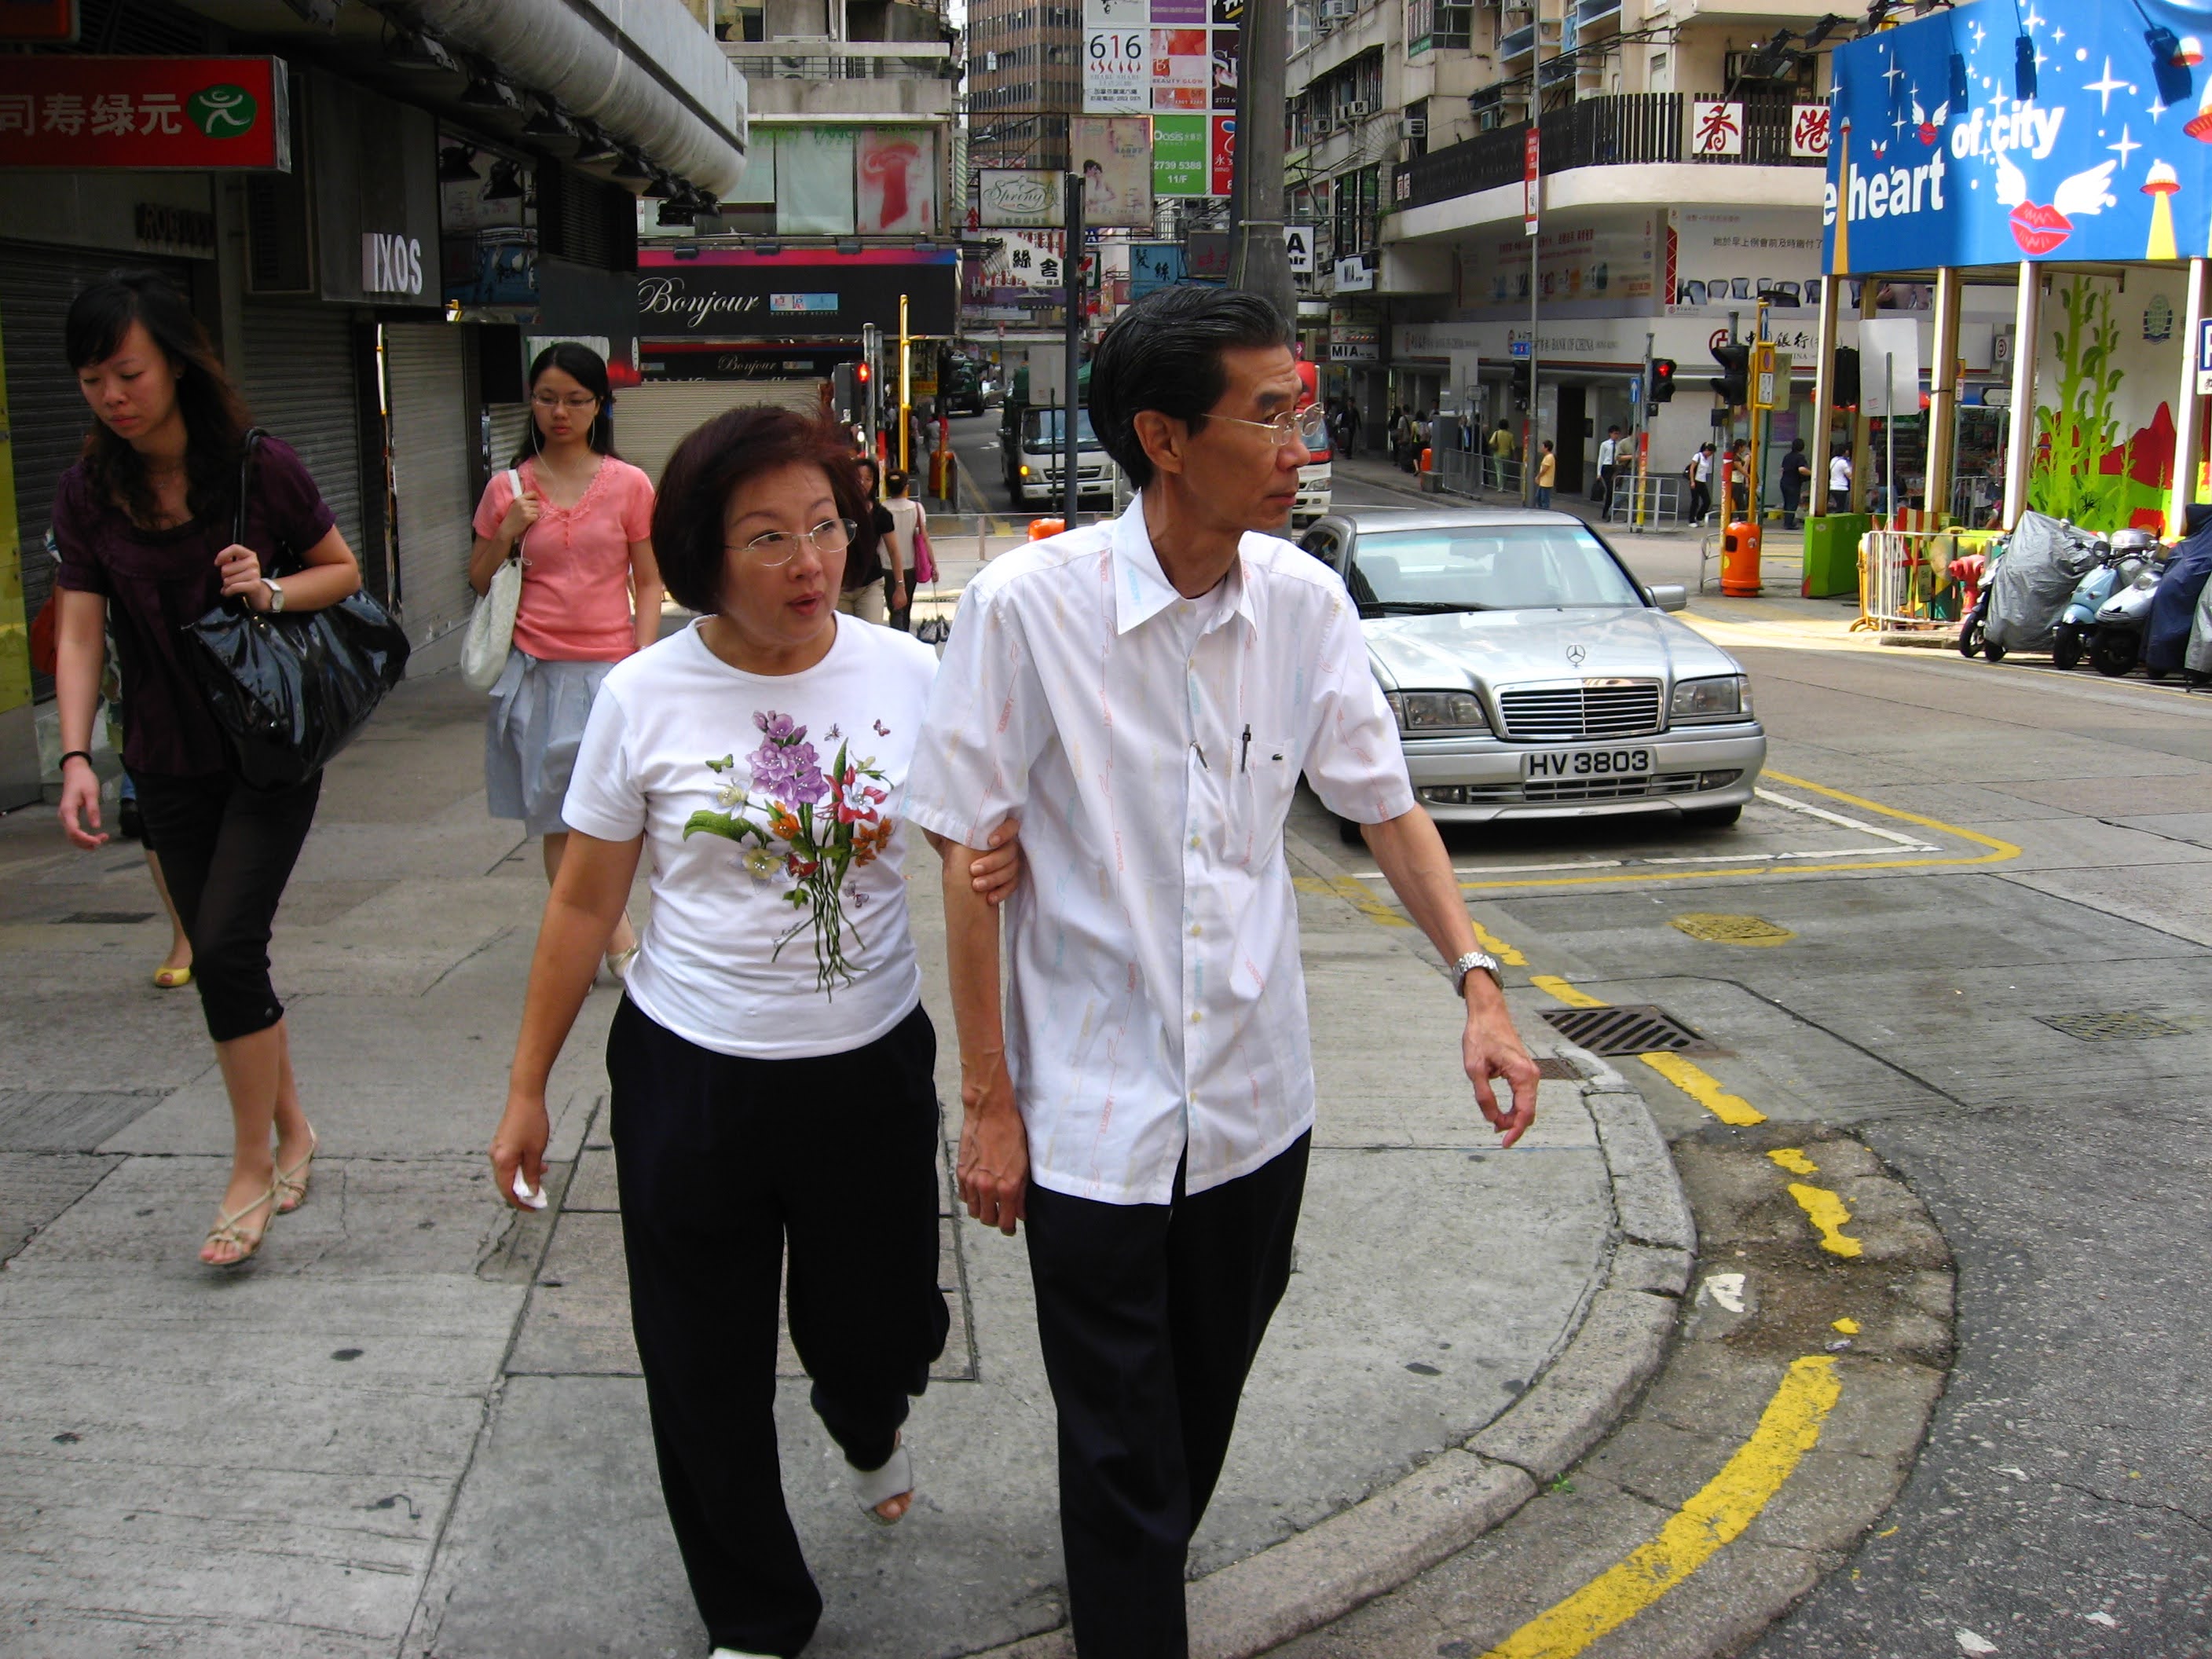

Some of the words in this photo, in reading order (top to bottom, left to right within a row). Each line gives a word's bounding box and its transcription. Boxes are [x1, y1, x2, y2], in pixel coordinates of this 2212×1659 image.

[1090, 35, 1141, 59] 616
[1154, 130, 1184, 141] Oasis
[1951, 108, 1984, 159] of
[1990, 100, 2065, 159] city
[1154, 160, 1177, 170] 2739
[1167, 175, 1188, 184] 11/F
[1848, 148, 1945, 222] heart
[983, 180, 1047, 211] Spring
[372, 233, 423, 295] IXOS
[638, 276, 760, 328] Bonjour
[1331, 346, 1359, 357] MIA
[718, 353, 777, 375] Bonjour
[1530, 754, 1566, 775] HV
[1574, 751, 1649, 774] 3803
